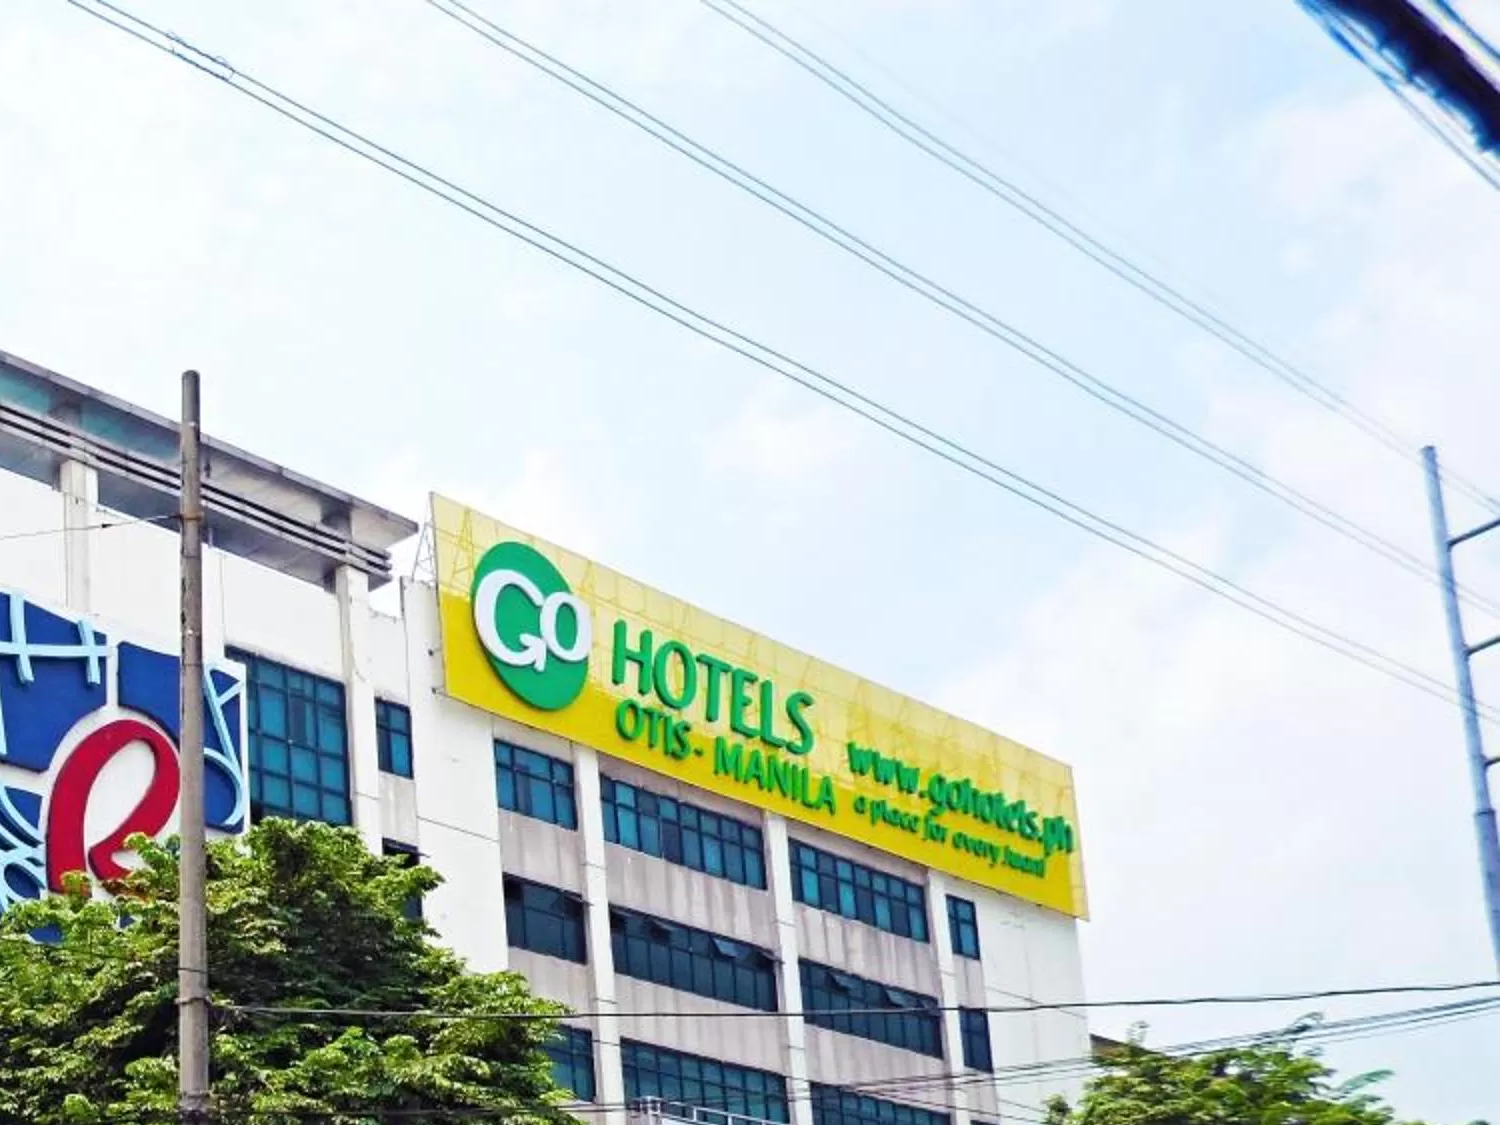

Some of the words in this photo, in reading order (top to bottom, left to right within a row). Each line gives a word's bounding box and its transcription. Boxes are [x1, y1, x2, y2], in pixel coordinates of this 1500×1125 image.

[611, 619, 815, 755] HOTELS
[713, 735, 837, 816] MANILA
[847, 741, 1074, 857] www.gohotels.ph
[922, 814, 949, 843] for
[952, 831, 1000, 868] every
